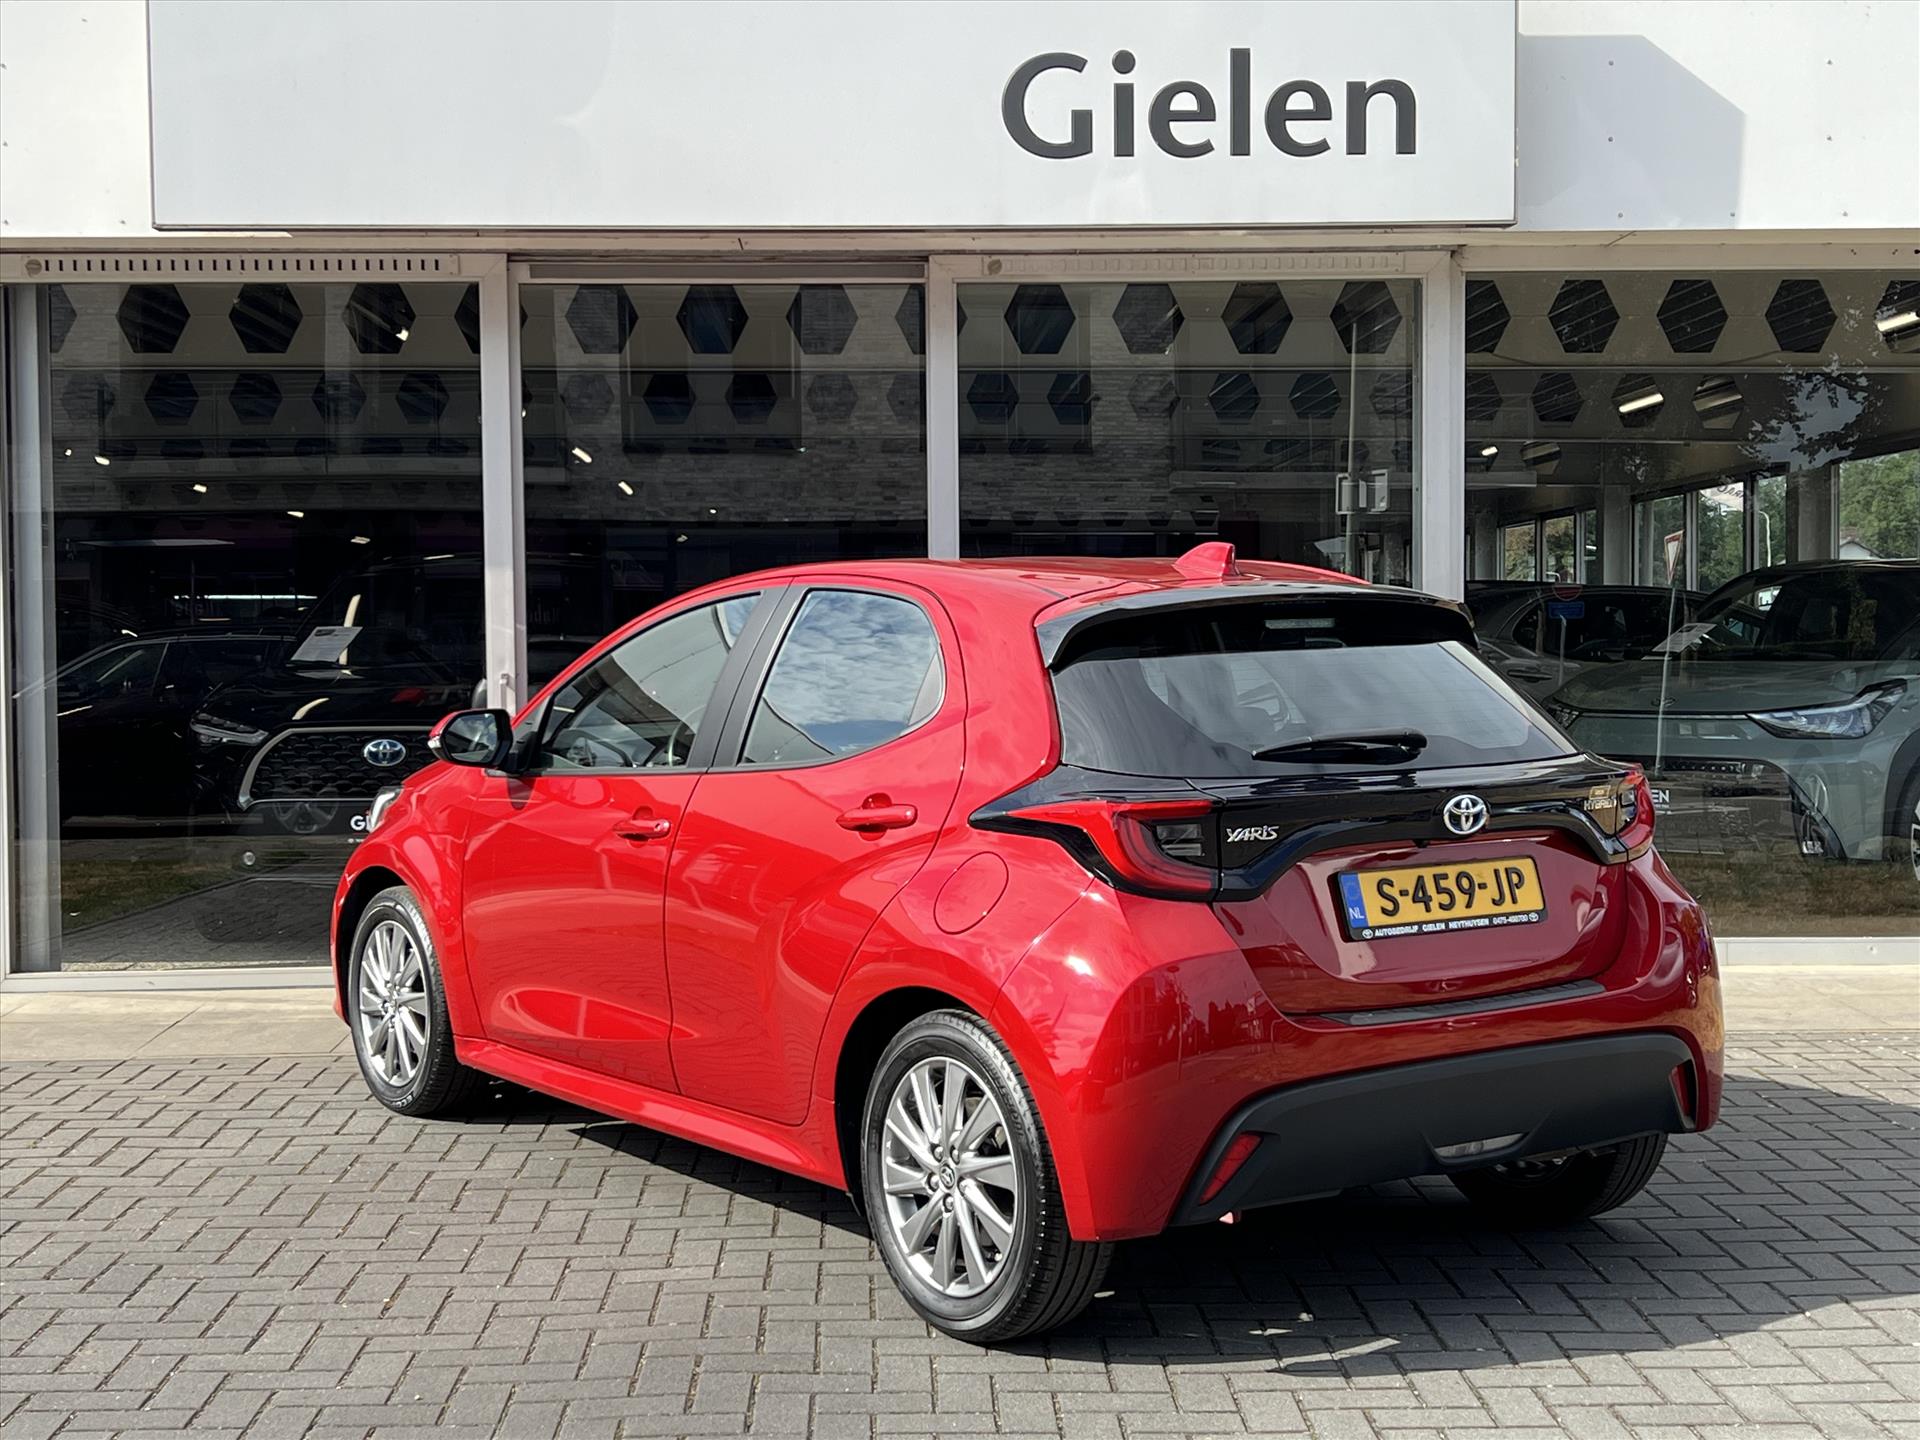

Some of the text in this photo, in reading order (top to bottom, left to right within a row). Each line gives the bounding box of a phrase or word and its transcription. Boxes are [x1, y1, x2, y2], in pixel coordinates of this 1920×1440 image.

[1001, 48, 1417, 158] Gielen
[1350, 907, 1365, 920] NL
[1377, 867, 1525, 917] S-459-JP
